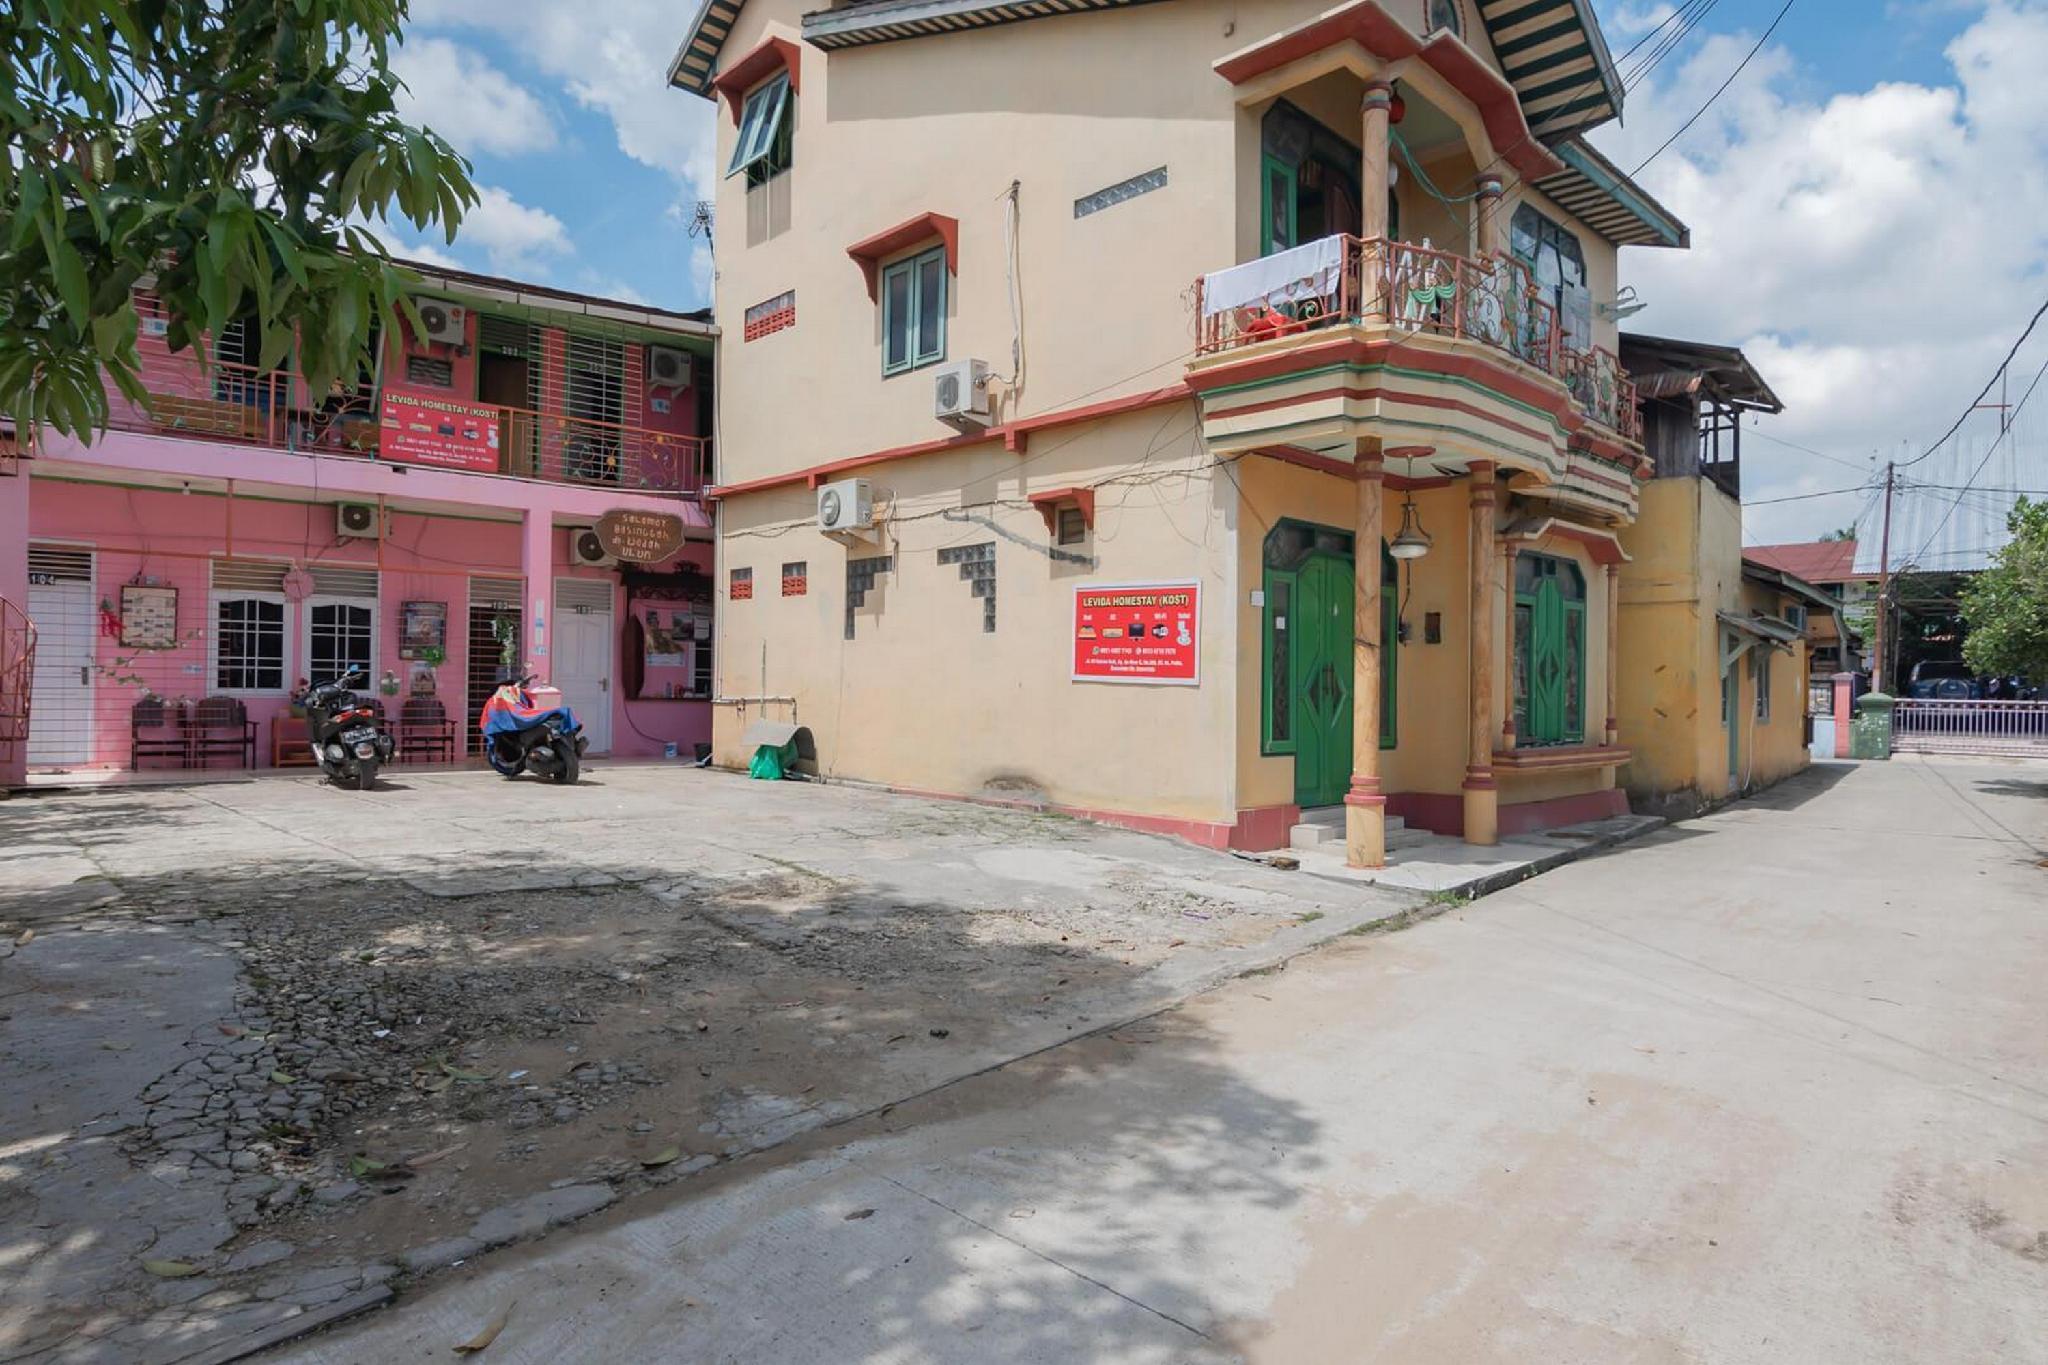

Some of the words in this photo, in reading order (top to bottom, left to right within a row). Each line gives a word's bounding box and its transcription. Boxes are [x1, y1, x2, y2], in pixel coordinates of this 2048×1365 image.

[386, 393, 419, 407] LEVIDA
[421, 399, 468, 415] HOMESTAY
[31, 574, 55, 585] 104
[1083, 596, 1111, 607] LEVIDA
[1113, 594, 1158, 607] HOMESTAY
[1159, 594, 1189, 608] (KOST)
